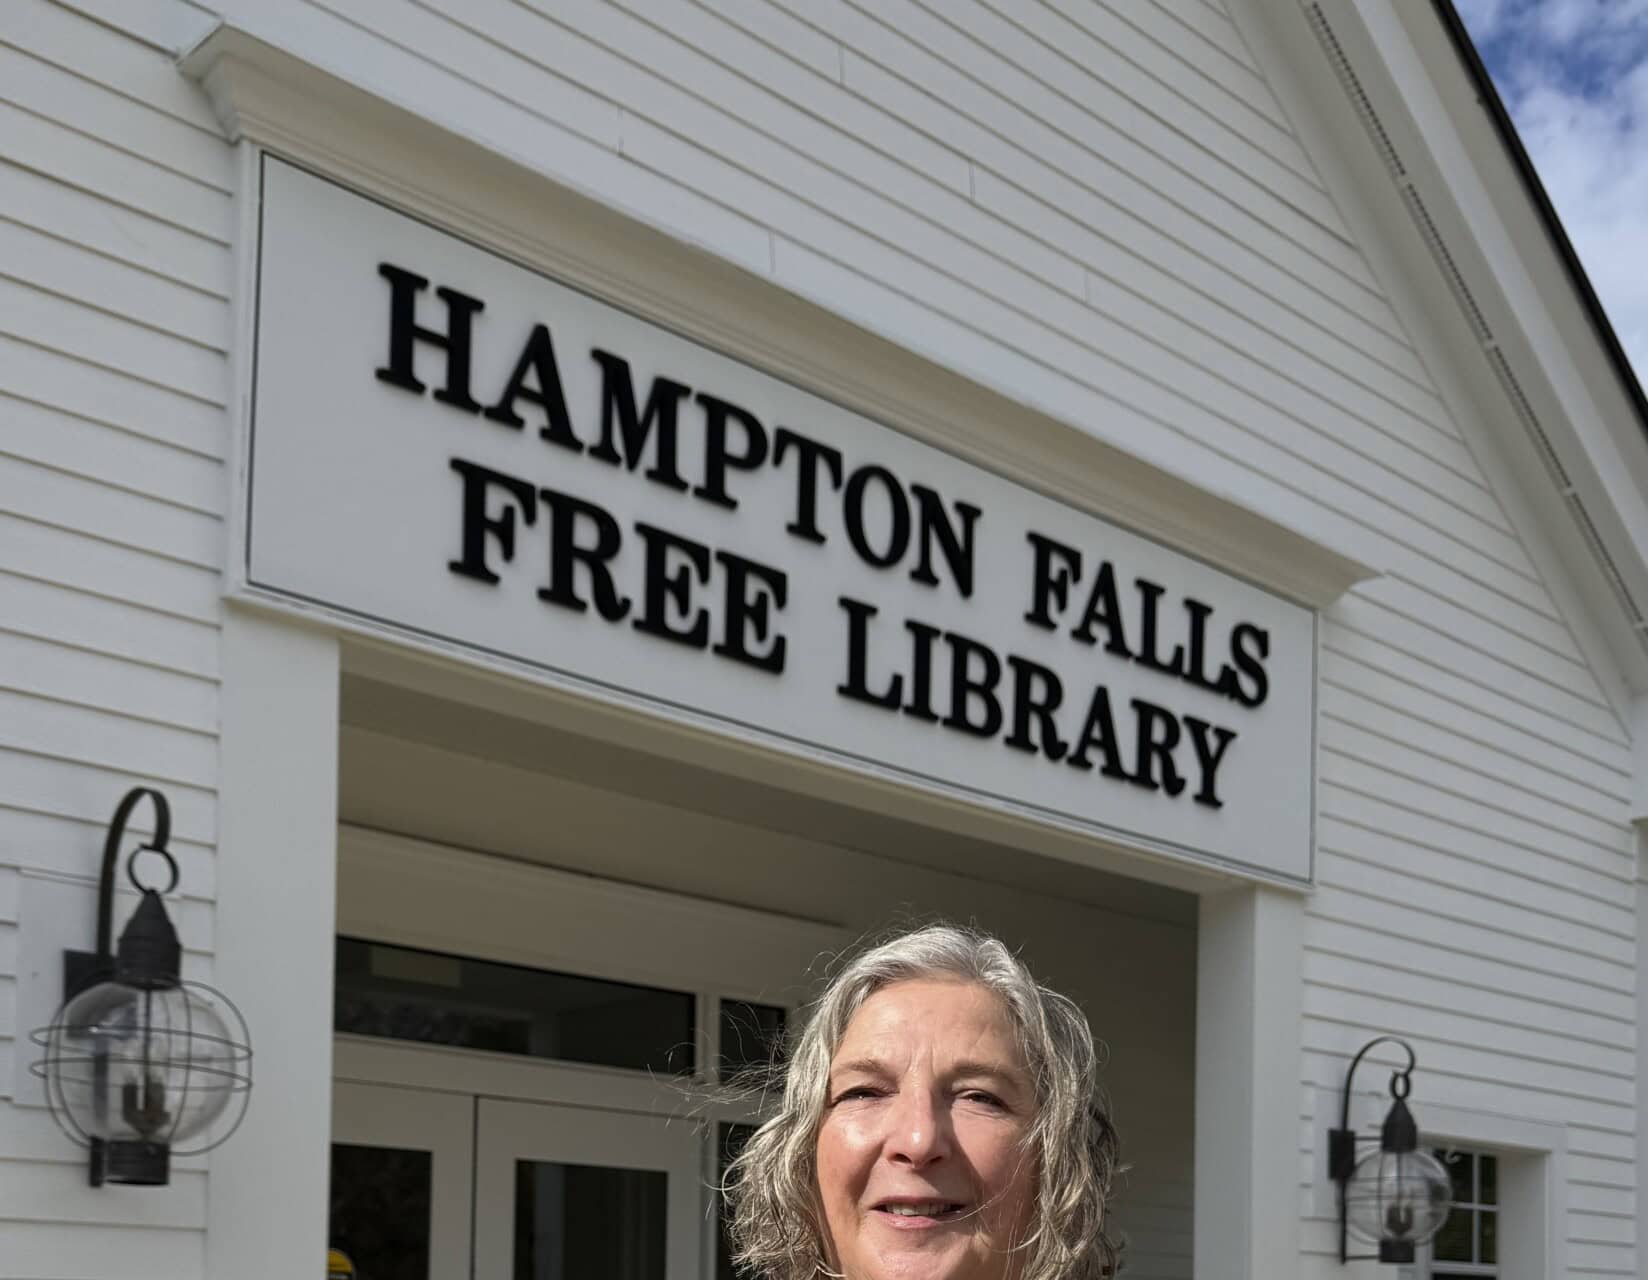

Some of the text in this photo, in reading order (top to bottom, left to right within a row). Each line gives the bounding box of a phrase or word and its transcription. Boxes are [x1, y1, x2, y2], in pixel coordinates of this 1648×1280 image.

[375, 262, 1270, 710] HAMPTON FALLS
[448, 457, 1239, 810] FREE LIBRARY
